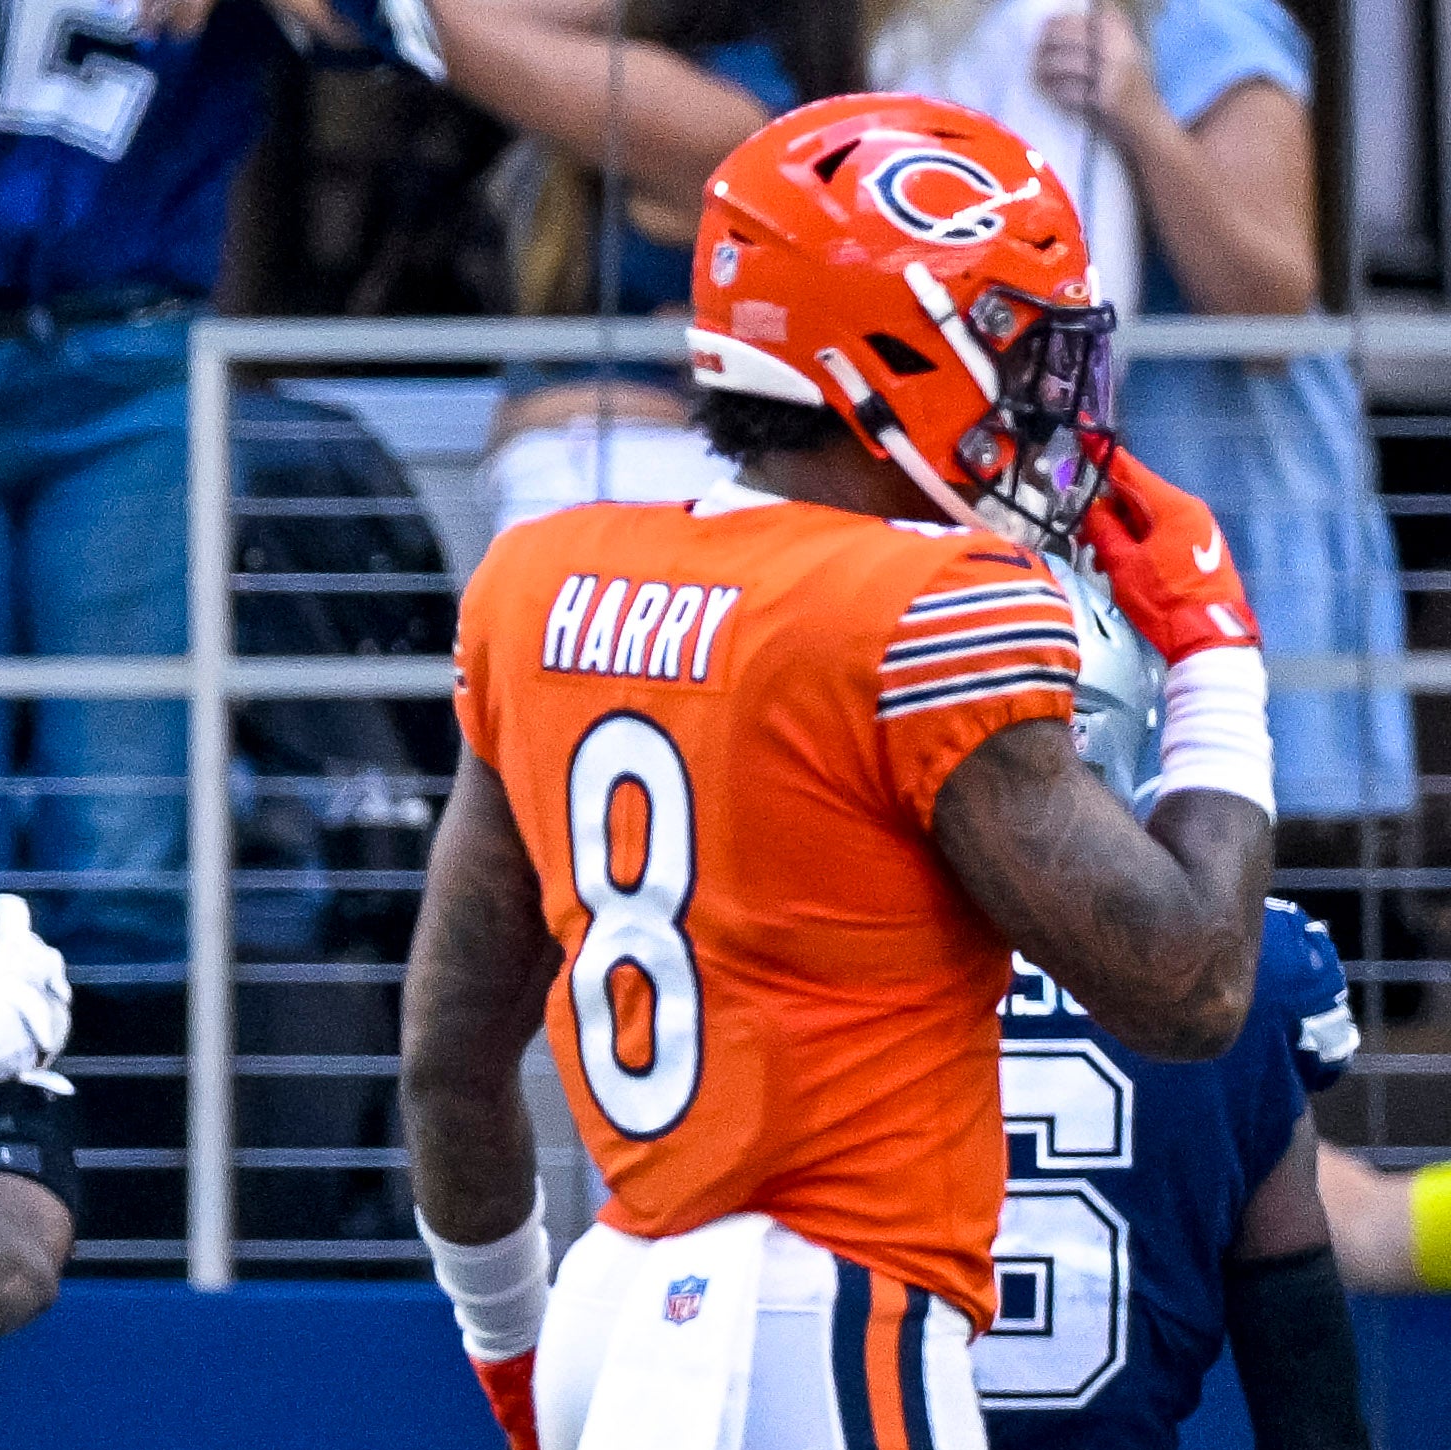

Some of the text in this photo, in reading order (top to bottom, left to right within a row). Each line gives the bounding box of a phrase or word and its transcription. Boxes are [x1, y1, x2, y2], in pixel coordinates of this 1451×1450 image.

[542, 574, 742, 683] HARRY
[568, 709, 702, 1140] 8
[972, 1038, 1134, 1411] 6
